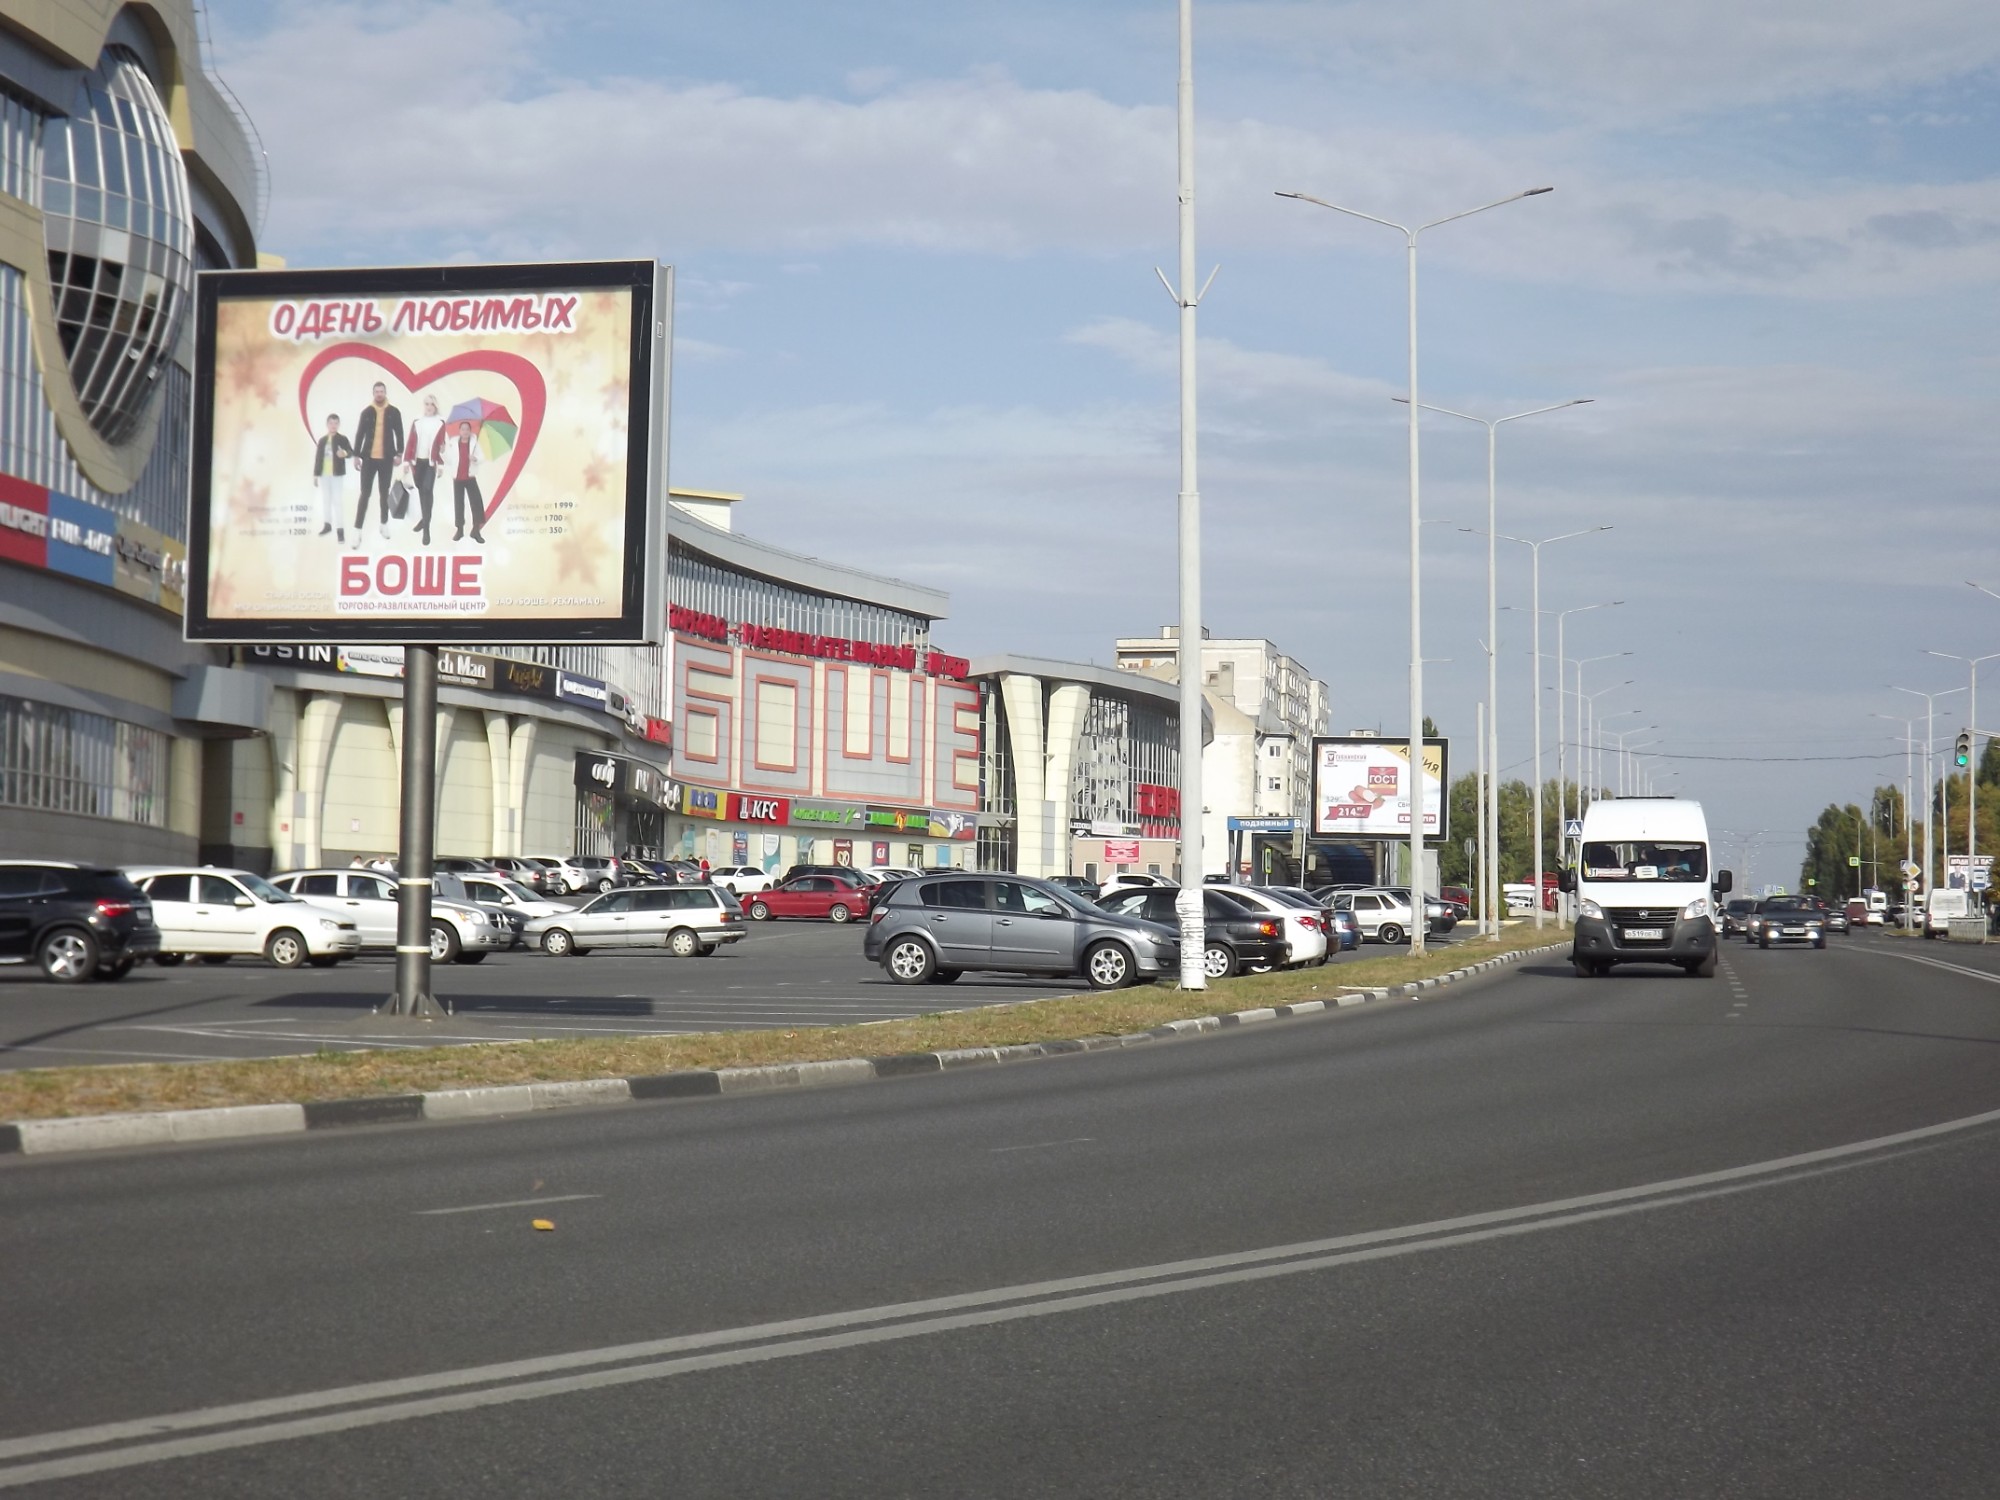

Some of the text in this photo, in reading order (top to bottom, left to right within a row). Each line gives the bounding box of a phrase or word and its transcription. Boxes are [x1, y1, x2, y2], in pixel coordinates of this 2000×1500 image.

[393, 297, 577, 332] ЛЮБИМЫХ
[340, 555, 483, 596] БОШЕ
[460, 602, 486, 611] ЦЕНТР
[457, 655, 486, 678] Man
[671, 634, 980, 811] БОШЕ
[1369, 774, 1397, 785] ГОСТ
[751, 801, 779, 820] KFC
[1338, 806, 1356, 817] 214
[1240, 819, 1290, 828] подземный
